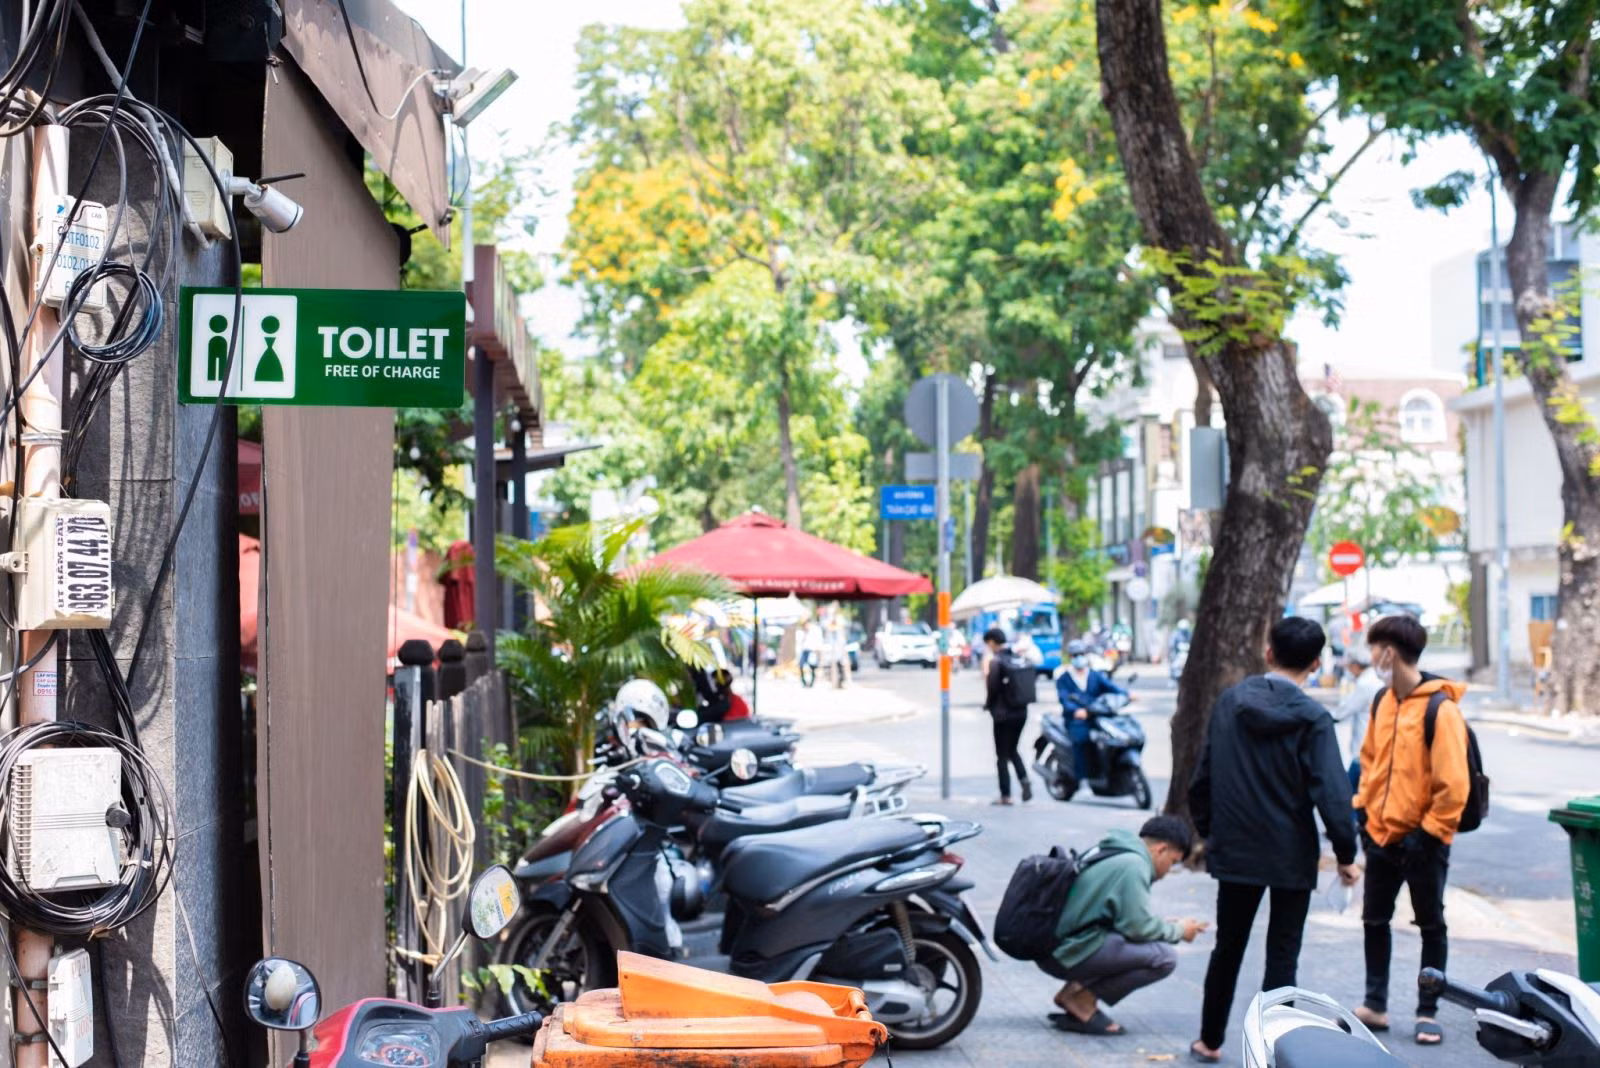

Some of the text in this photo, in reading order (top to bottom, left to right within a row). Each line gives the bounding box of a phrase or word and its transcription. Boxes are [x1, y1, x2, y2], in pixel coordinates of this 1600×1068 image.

[317, 326, 450, 360] TOILET
[325, 364, 441, 379] FREE OF CHARGE
[67, 517, 109, 613] 963.07.44.70
